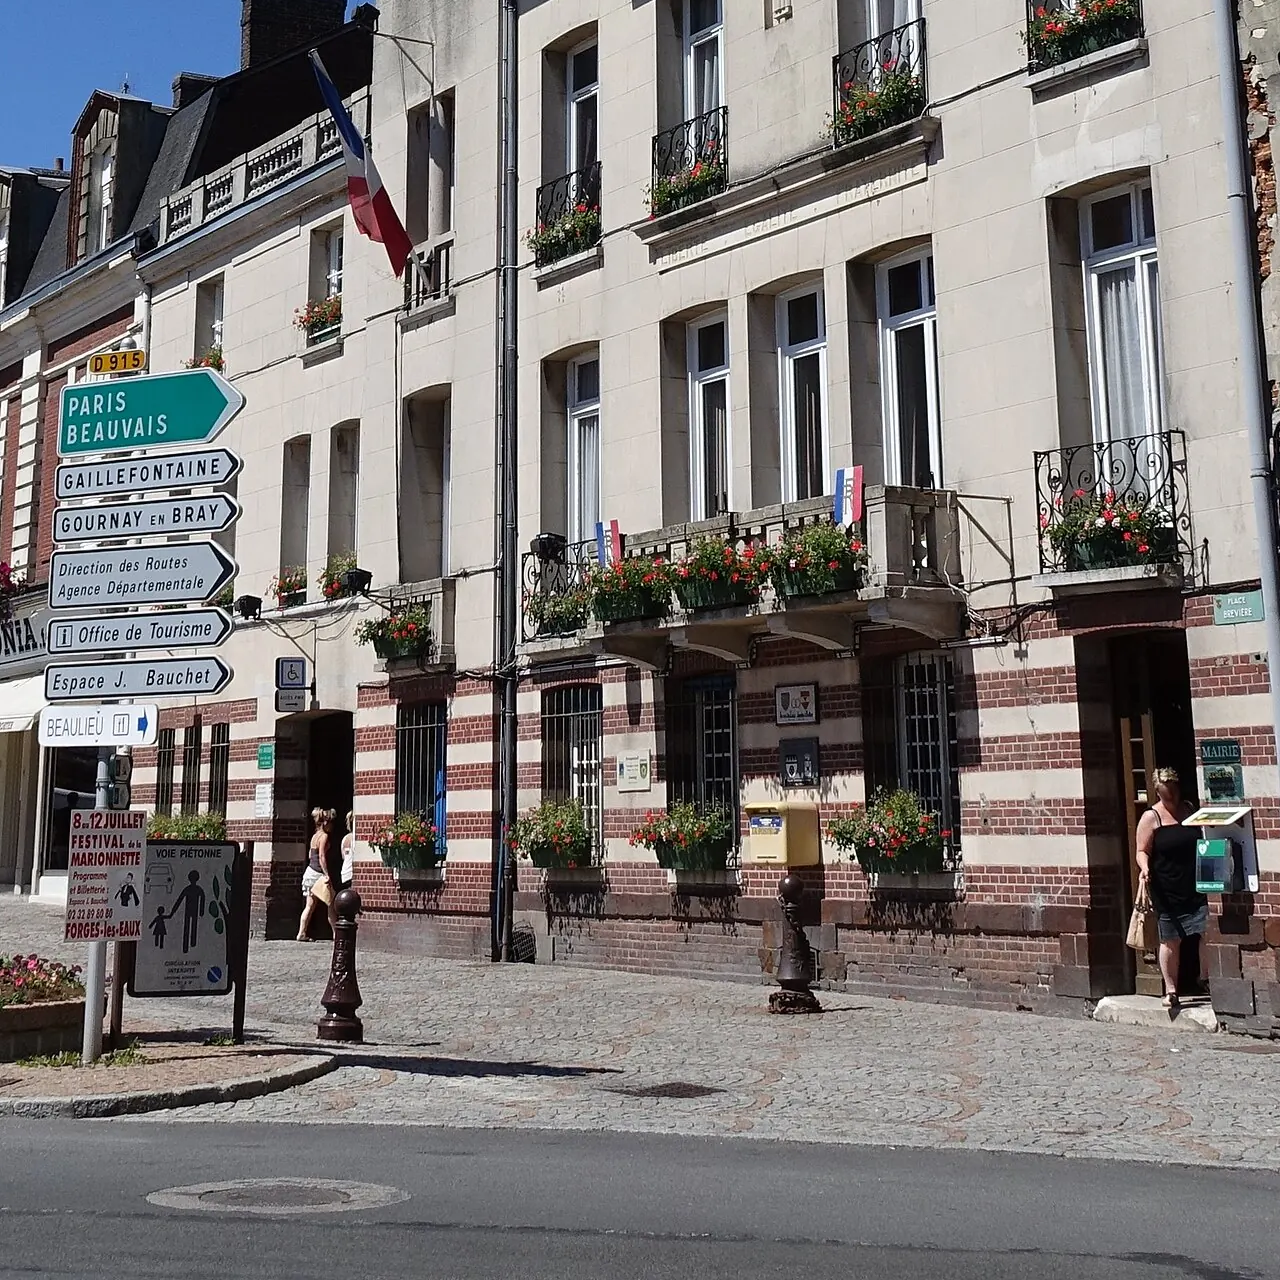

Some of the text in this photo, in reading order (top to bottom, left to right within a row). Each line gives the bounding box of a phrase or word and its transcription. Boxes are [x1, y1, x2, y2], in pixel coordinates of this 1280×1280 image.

[94, 353, 141, 372] D 915
[68, 391, 126, 417] PARIS
[67, 414, 168, 445] BEAUVAIS
[64, 458, 220, 490] GAILLEFONTAINE
[61, 504, 219, 533] GOURNAY EN BRAY
[59, 557, 188, 577] Direction des Routes
[58, 576, 204, 600] Agence Départementale
[1227, 596, 1246, 605] PLACE
[79, 625, 119, 643] Office
[125, 624, 142, 641] de
[149, 620, 212, 640] Tourisme
[53, 667, 211, 694] Espace J. Bauchet
[47, 715, 104, 737] BEAULIEU
[1201, 744, 1239, 758] MAIRIE
[73, 812, 82, 829] 8
[89, 812, 103, 829] 12
[103, 812, 144, 829] JUILLET
[71, 834, 125, 849] FESTIVAL
[71, 851, 141, 866] MARIONNETTE
[156, 846, 222, 859] VOIE PIÉTONNE
[73, 871, 108, 882] Programme
